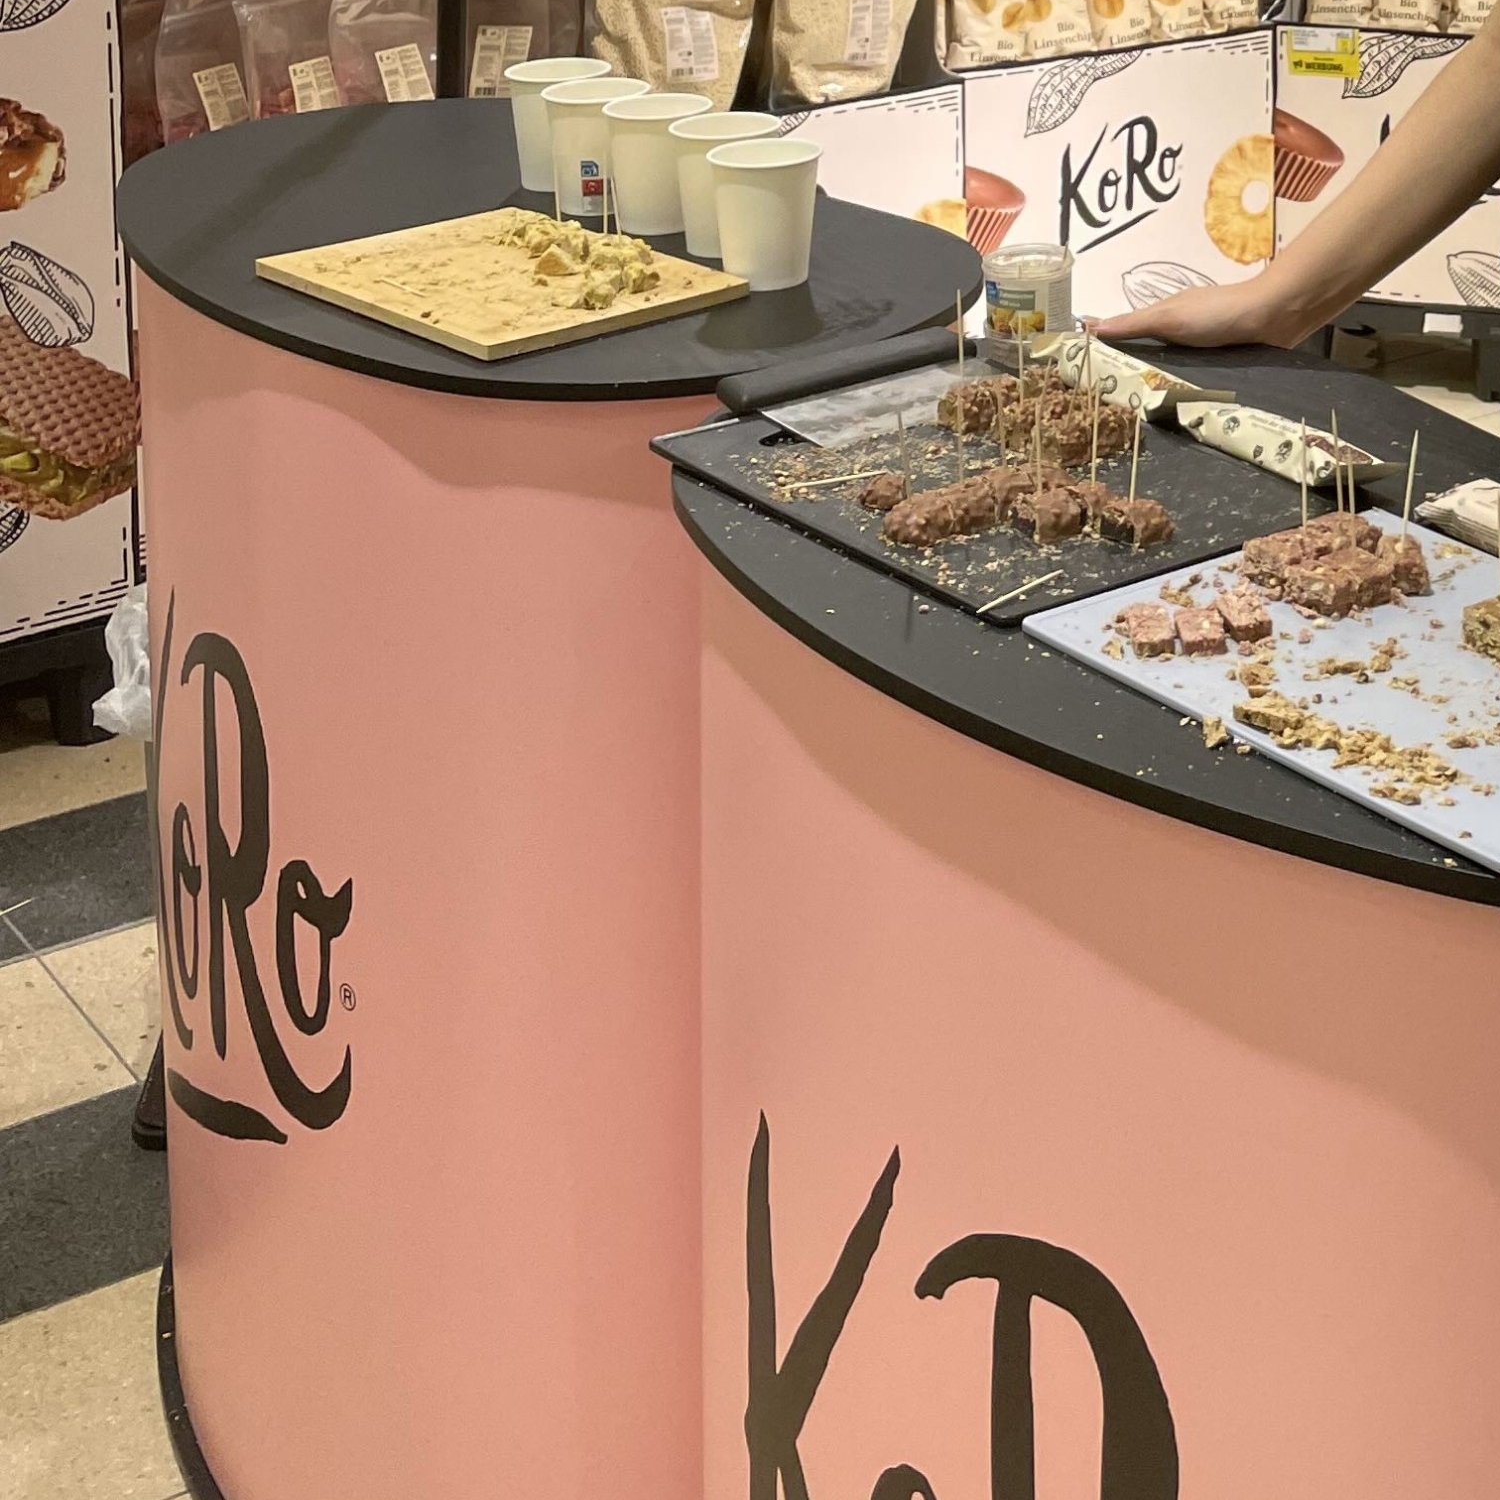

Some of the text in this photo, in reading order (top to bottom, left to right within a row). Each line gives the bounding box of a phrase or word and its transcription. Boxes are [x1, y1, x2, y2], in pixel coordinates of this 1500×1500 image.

[1057, 21, 1075, 32] Bio
[1130, 17, 1145, 28] Bio
[997, 39, 1014, 50] Bio
[1059, 115, 1183, 253] KoRo
